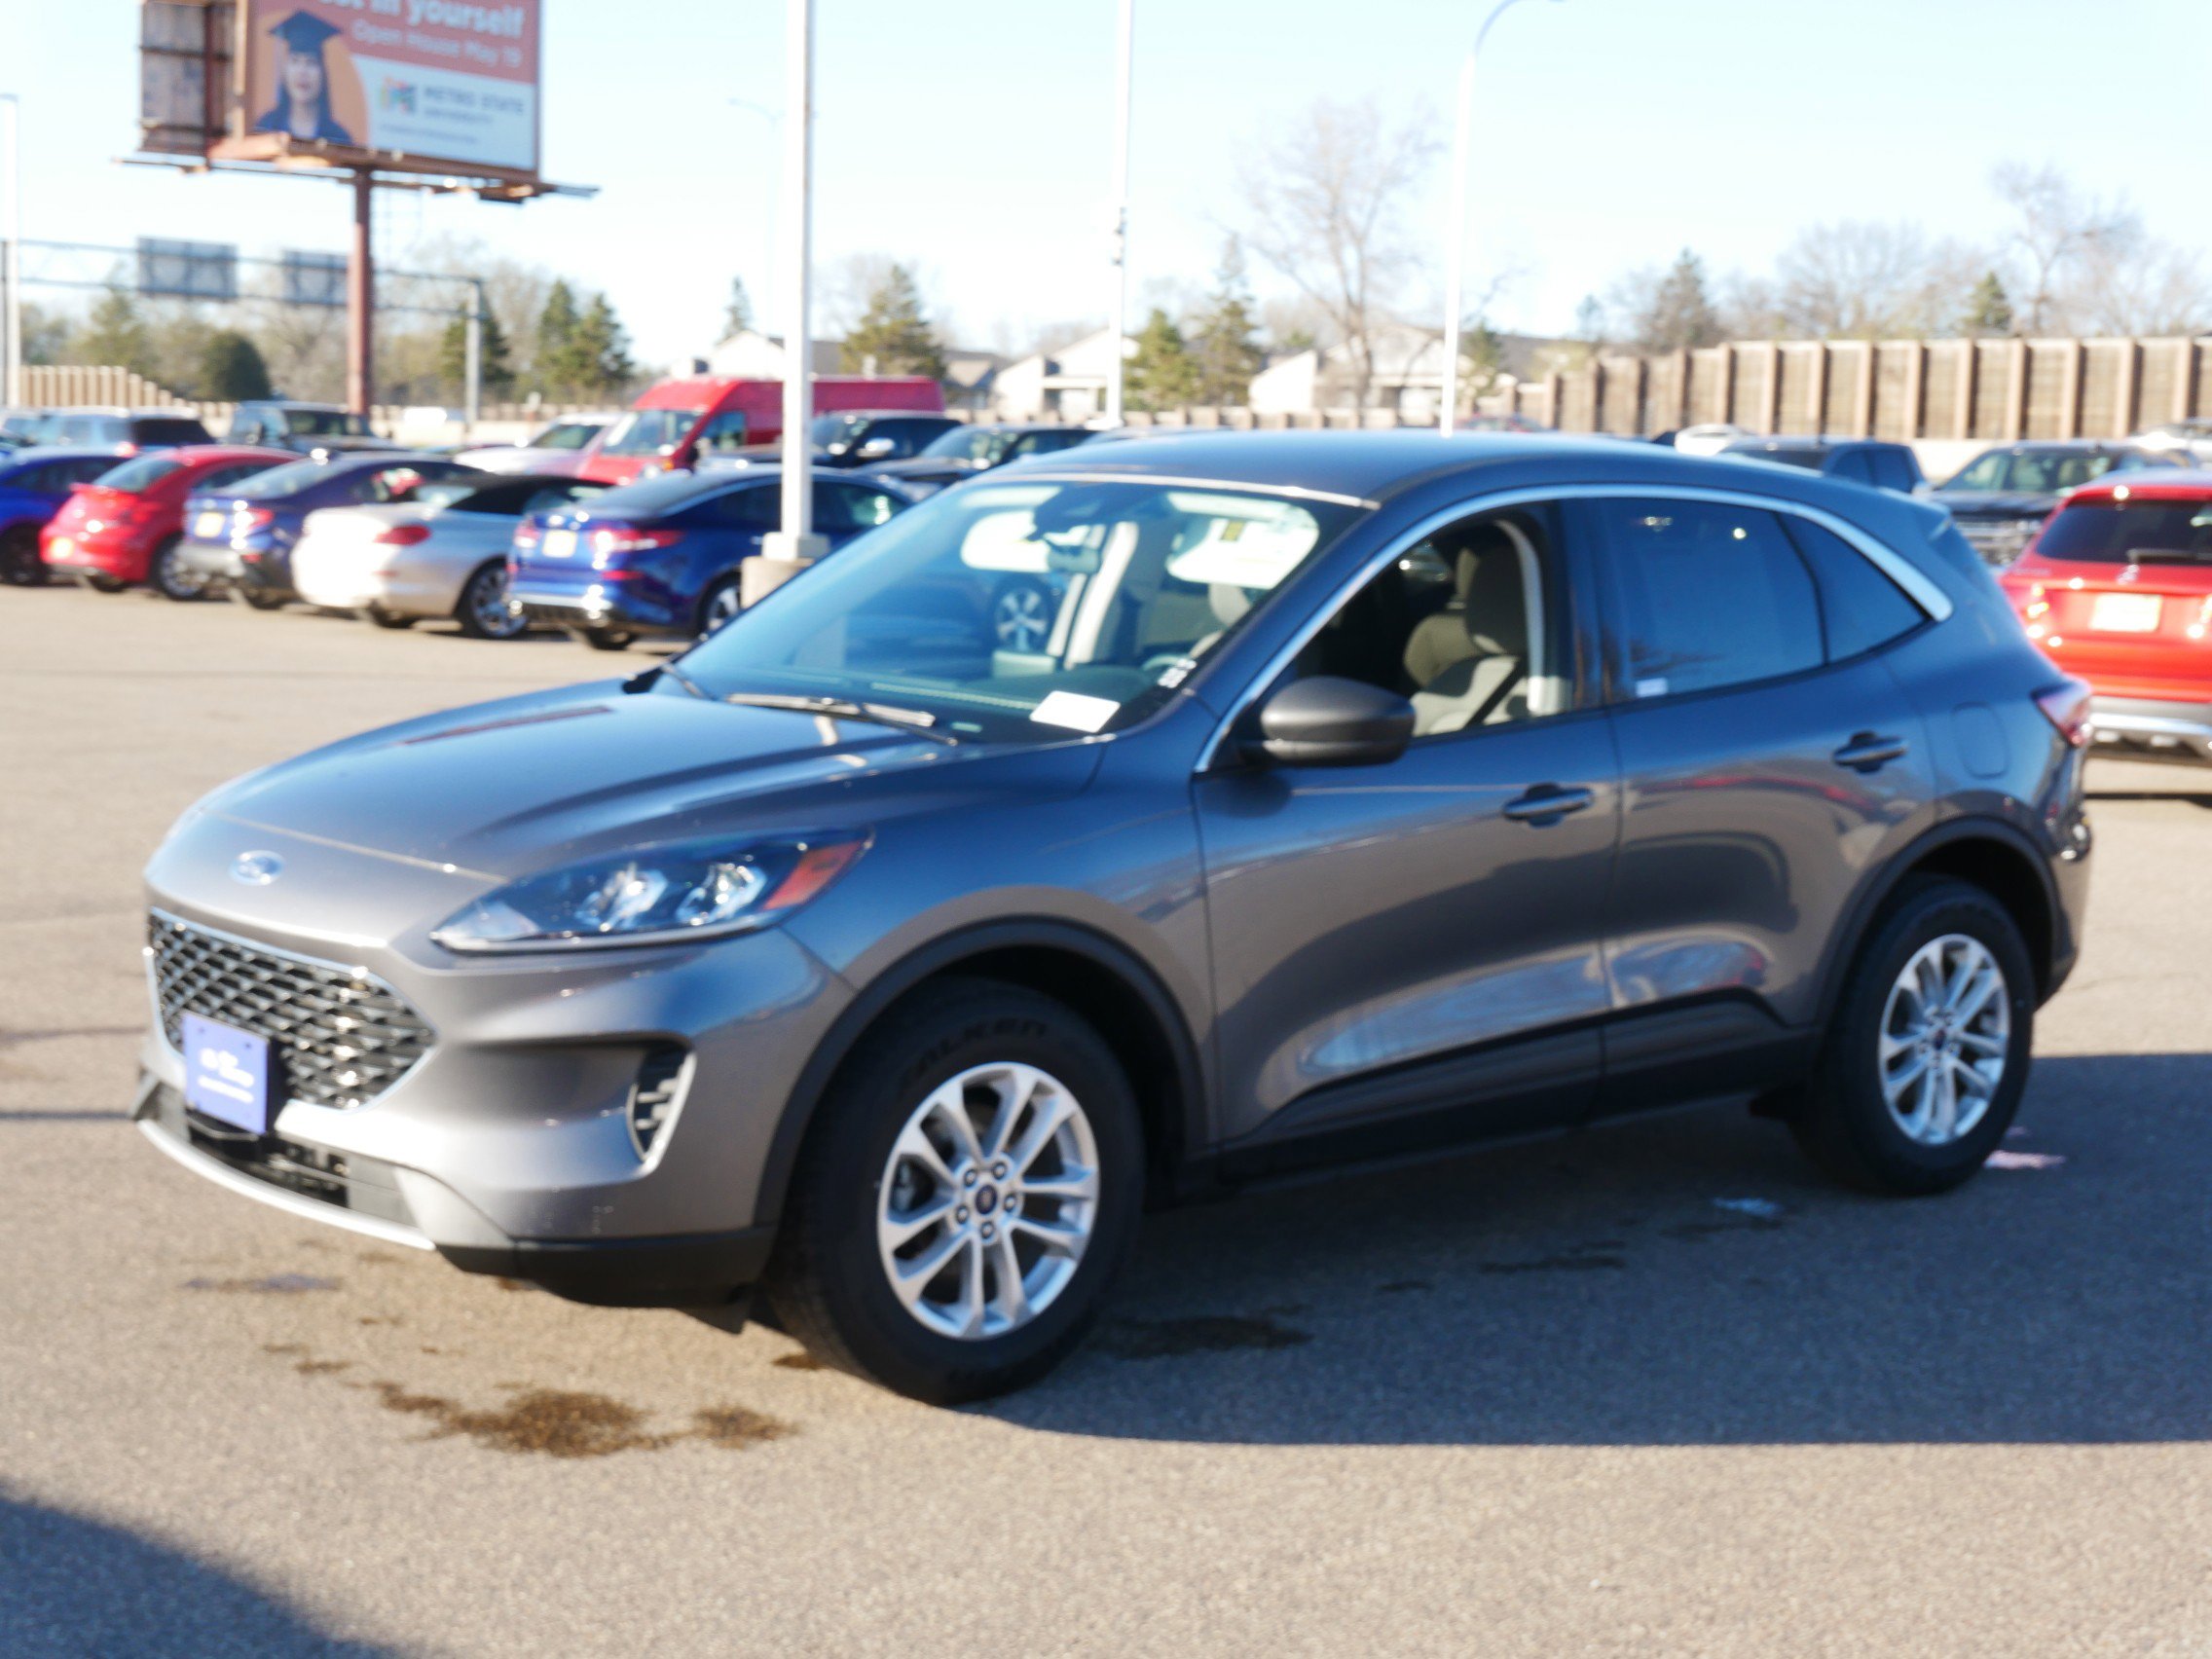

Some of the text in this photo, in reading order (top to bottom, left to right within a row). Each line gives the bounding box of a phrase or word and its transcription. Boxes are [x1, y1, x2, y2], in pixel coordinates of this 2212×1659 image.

[408, 0, 524, 38] yourself
[353, 18, 402, 46] Open
[406, 31, 461, 58] House
[464, 40, 499, 67] May
